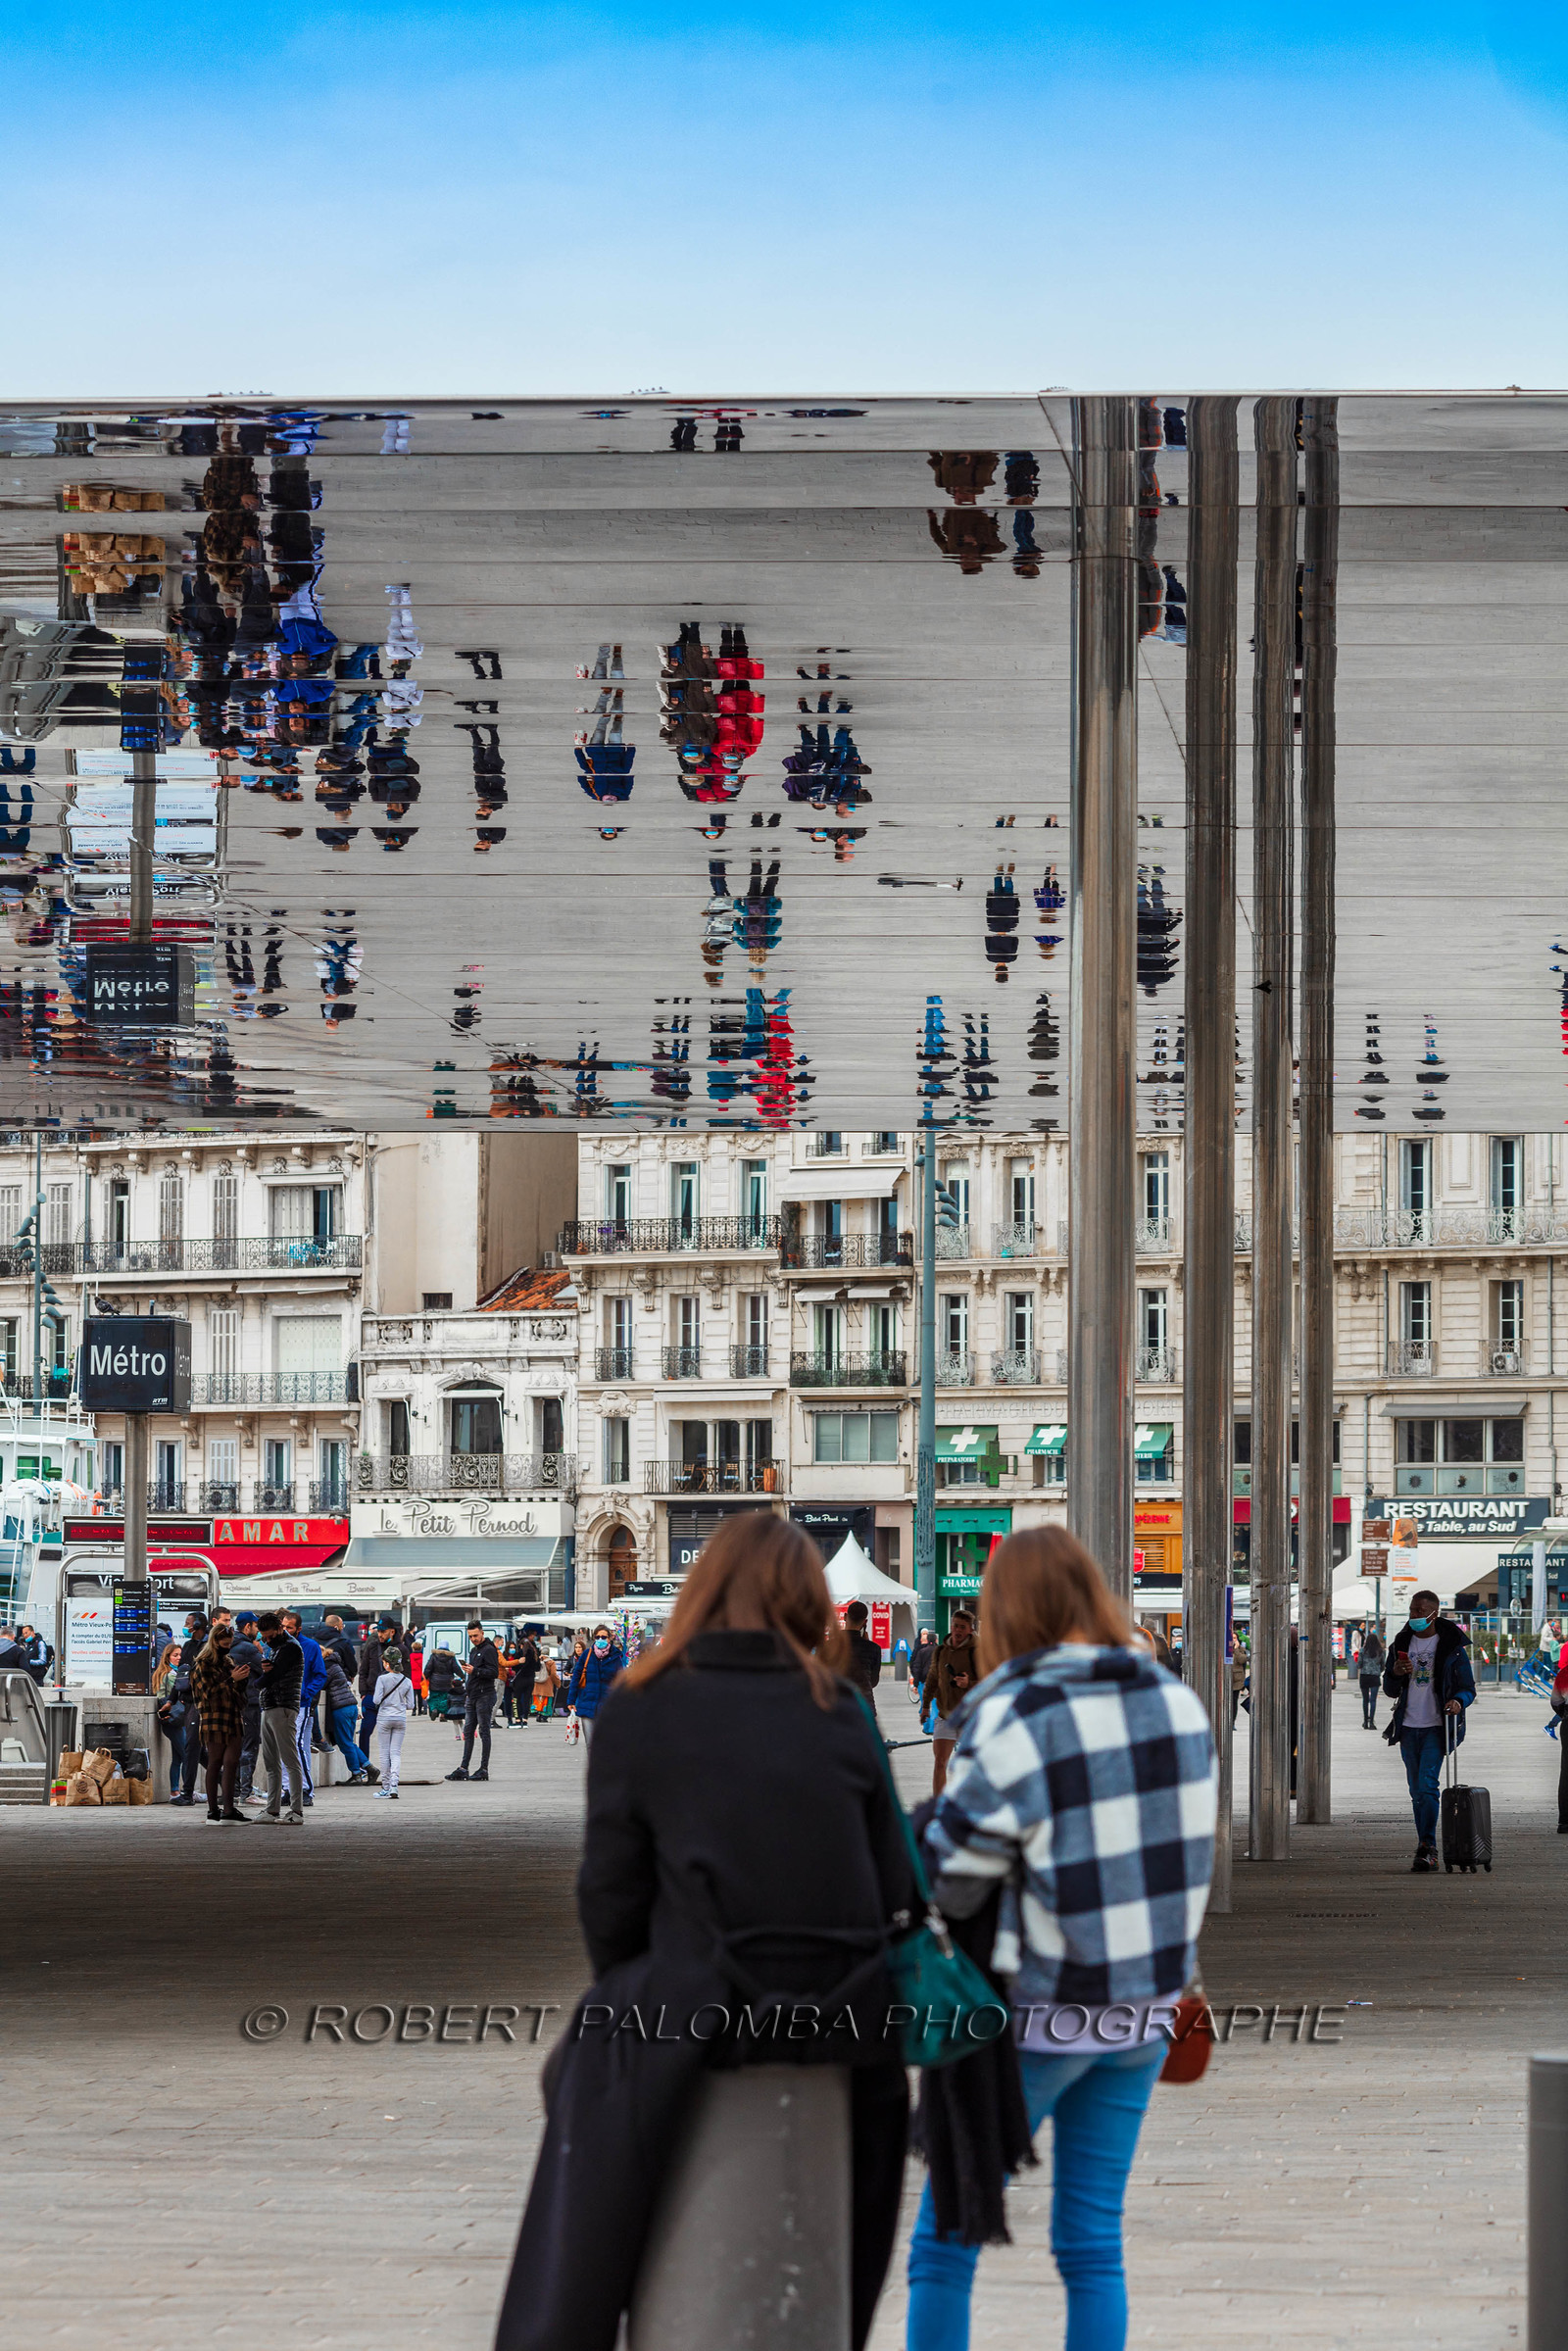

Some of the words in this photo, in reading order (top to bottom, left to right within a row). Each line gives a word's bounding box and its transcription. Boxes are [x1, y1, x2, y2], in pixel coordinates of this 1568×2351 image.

[90, 1345, 167, 1376] Métro
[402, 1499, 454, 1535] Petit
[460, 1499, 535, 1535] Pernod
[1383, 1501, 1530, 1518] RESTAURANT
[1426, 1521, 1466, 1534] Table,
[1468, 1523, 1486, 1533] au
[1488, 1521, 1517, 1533] Sud
[1499, 1558, 1566, 1567] RESTAANT
